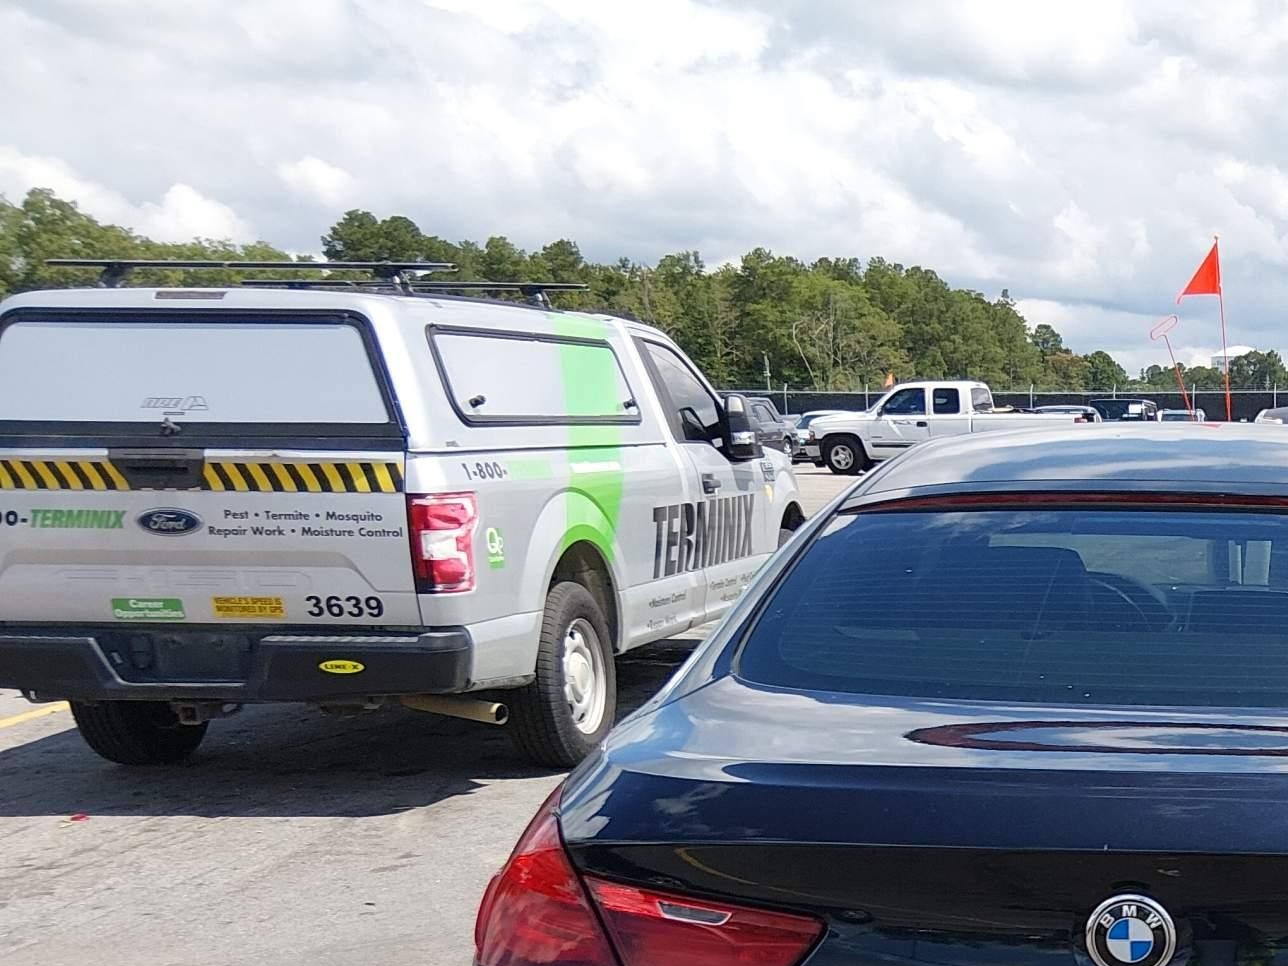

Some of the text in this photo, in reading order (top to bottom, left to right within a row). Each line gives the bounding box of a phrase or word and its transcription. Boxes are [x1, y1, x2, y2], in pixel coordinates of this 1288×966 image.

[150, 513, 186, 530] Ford
[223, 510, 383, 524] Pest Termite Mosquito
[208, 525, 403, 538] Repair Work Moisture Control
[653, 493, 755, 580] TERMINIX
[305, 595, 384, 617] 3639
[1100, 904, 1162, 929] BMW
